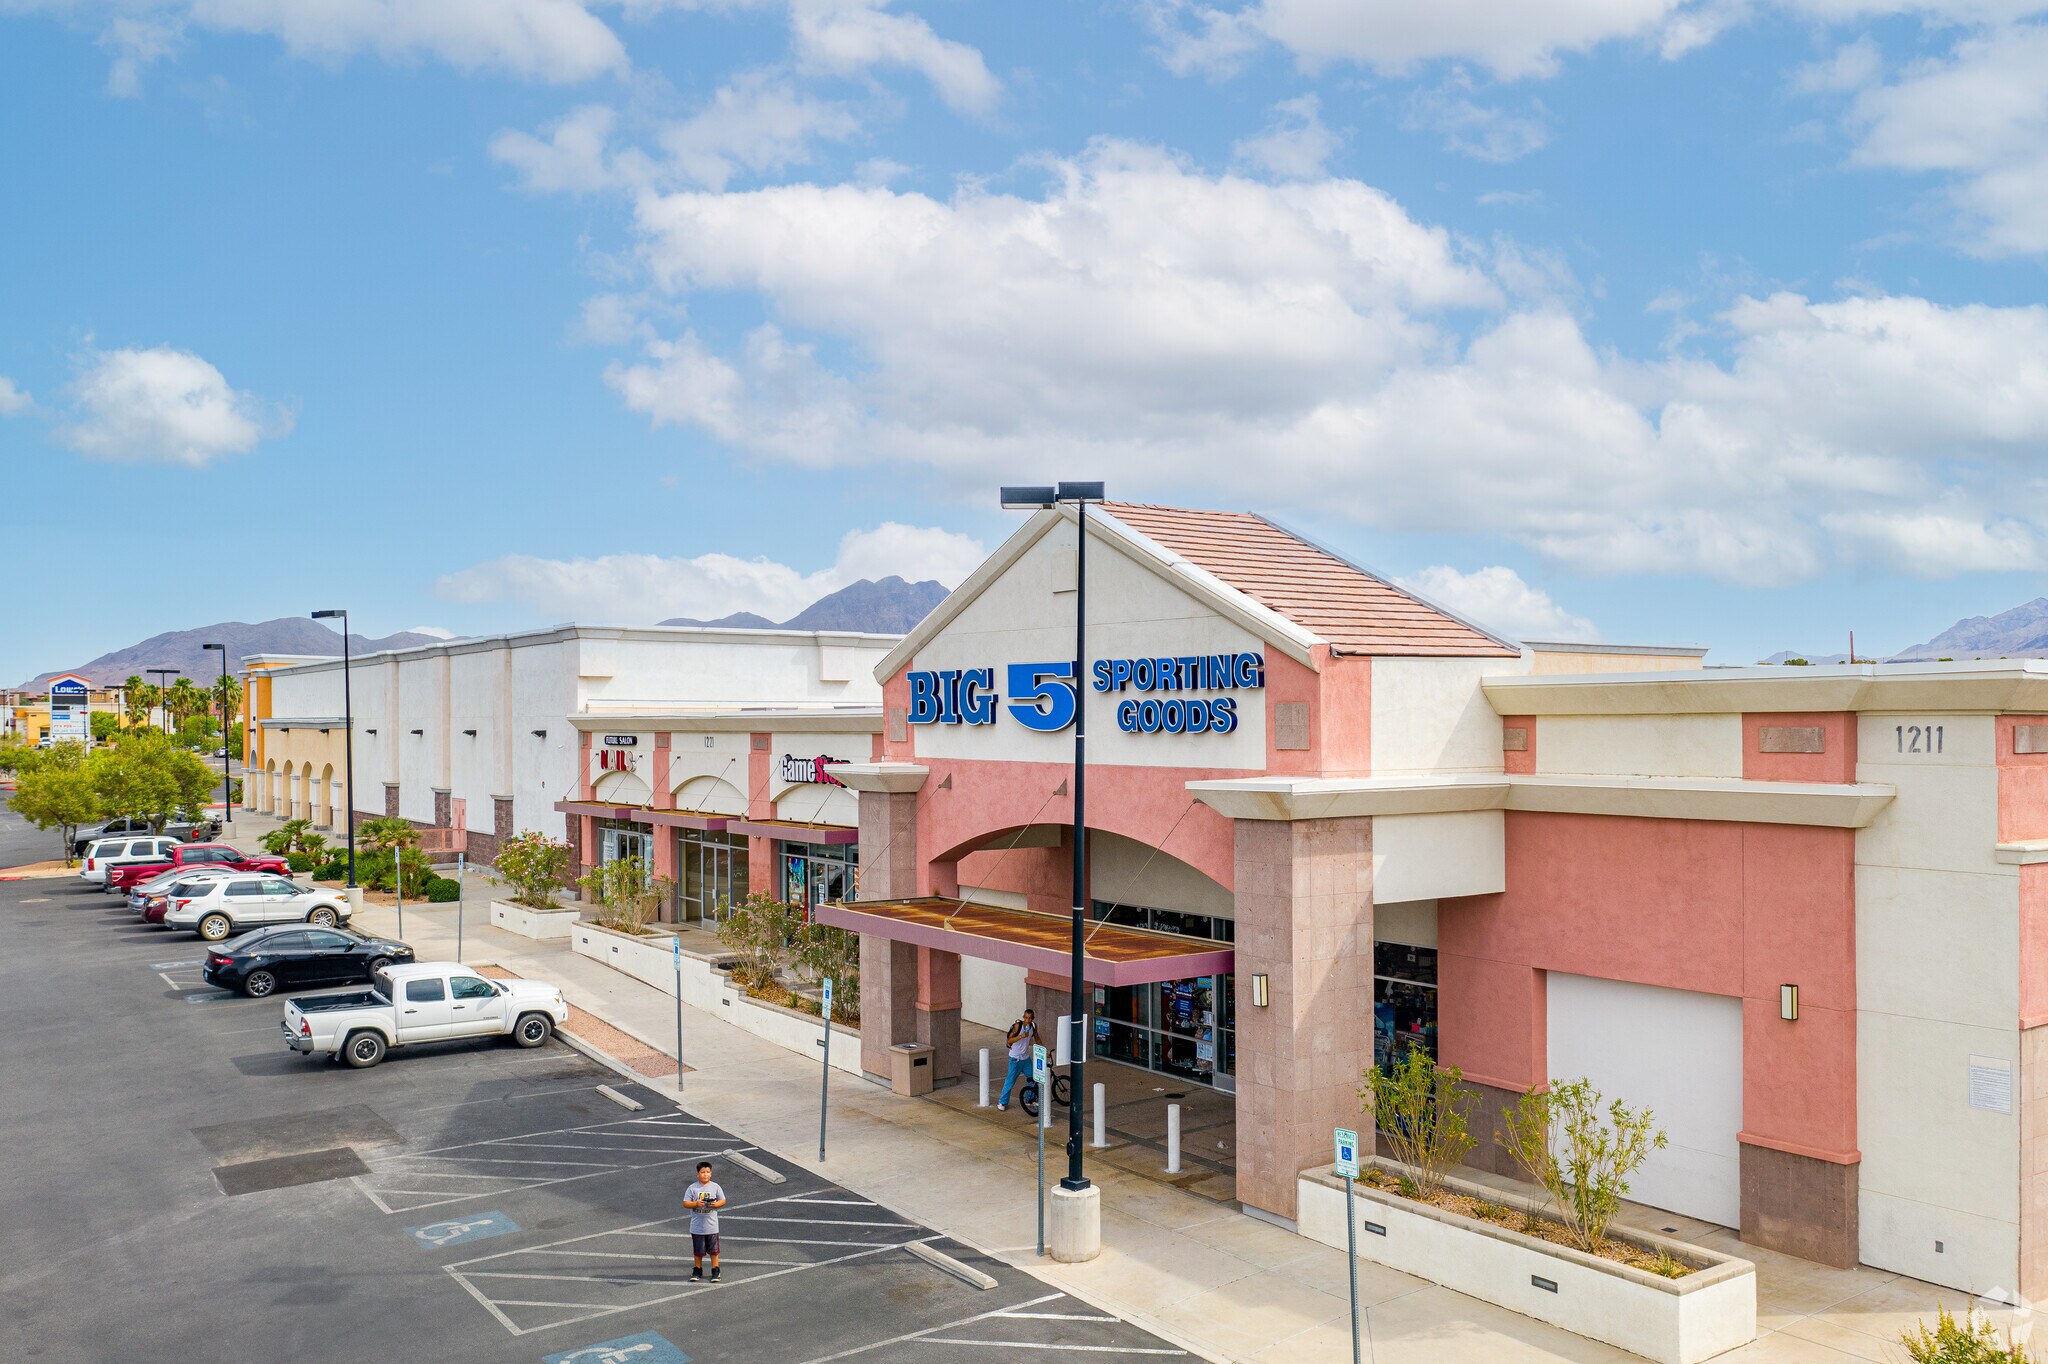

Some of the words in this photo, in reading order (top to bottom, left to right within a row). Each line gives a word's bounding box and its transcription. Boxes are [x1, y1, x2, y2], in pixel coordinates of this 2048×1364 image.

[1092, 653, 1264, 692] SPORTING
[907, 668, 997, 726] BIG
[1007, 661, 1077, 732] 5
[1117, 697, 1237, 734] GOODS
[704, 736, 714, 748] 1221
[1896, 725, 1943, 753] 1211
[600, 749, 635, 771] NAILS
